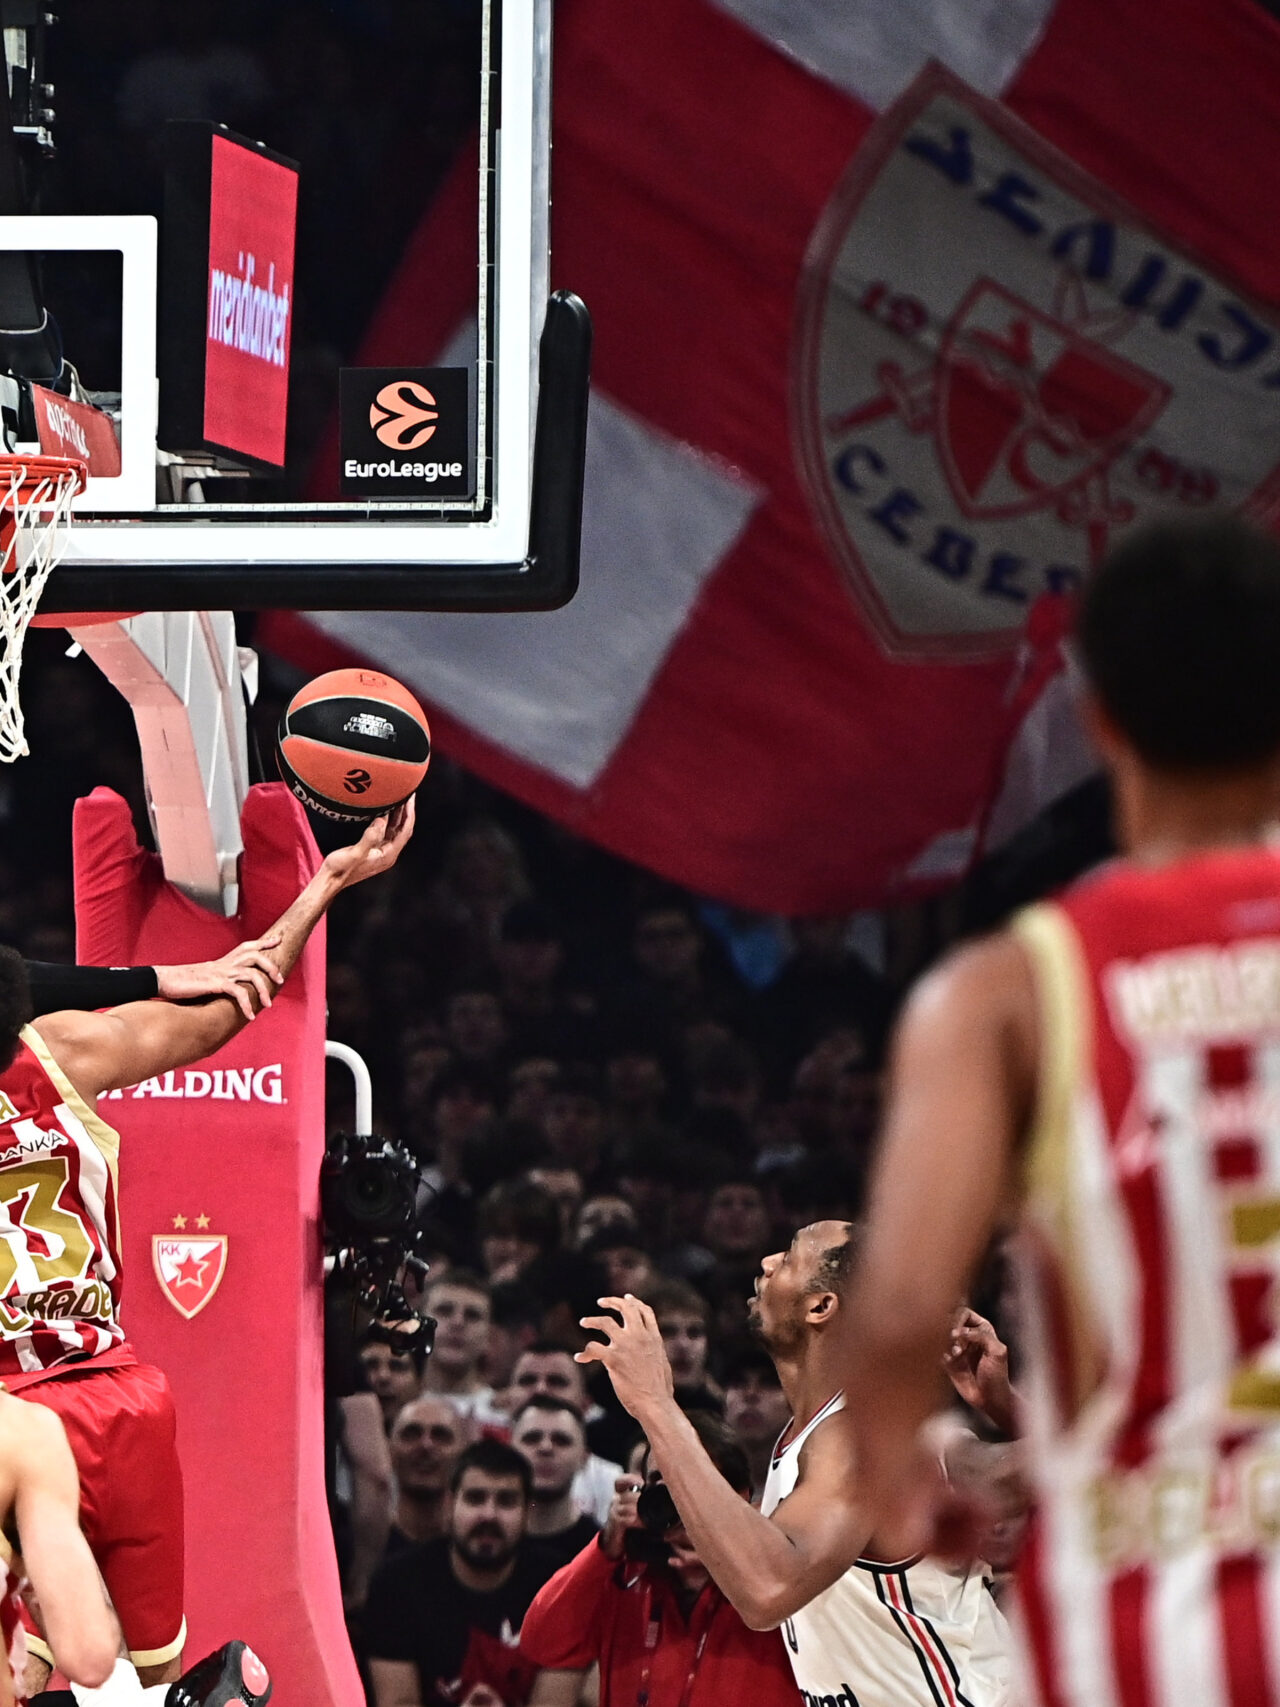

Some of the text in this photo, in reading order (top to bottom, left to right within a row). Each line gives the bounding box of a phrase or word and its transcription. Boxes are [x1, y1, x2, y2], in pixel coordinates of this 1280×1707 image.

[904, 124, 1280, 392] ДЕЛИЈ
[209, 250, 289, 368] meridianbet
[344, 459, 463, 483] EuroLeague
[96, 1063, 282, 1104] ALDING
[161, 1243, 181, 1256] KK
